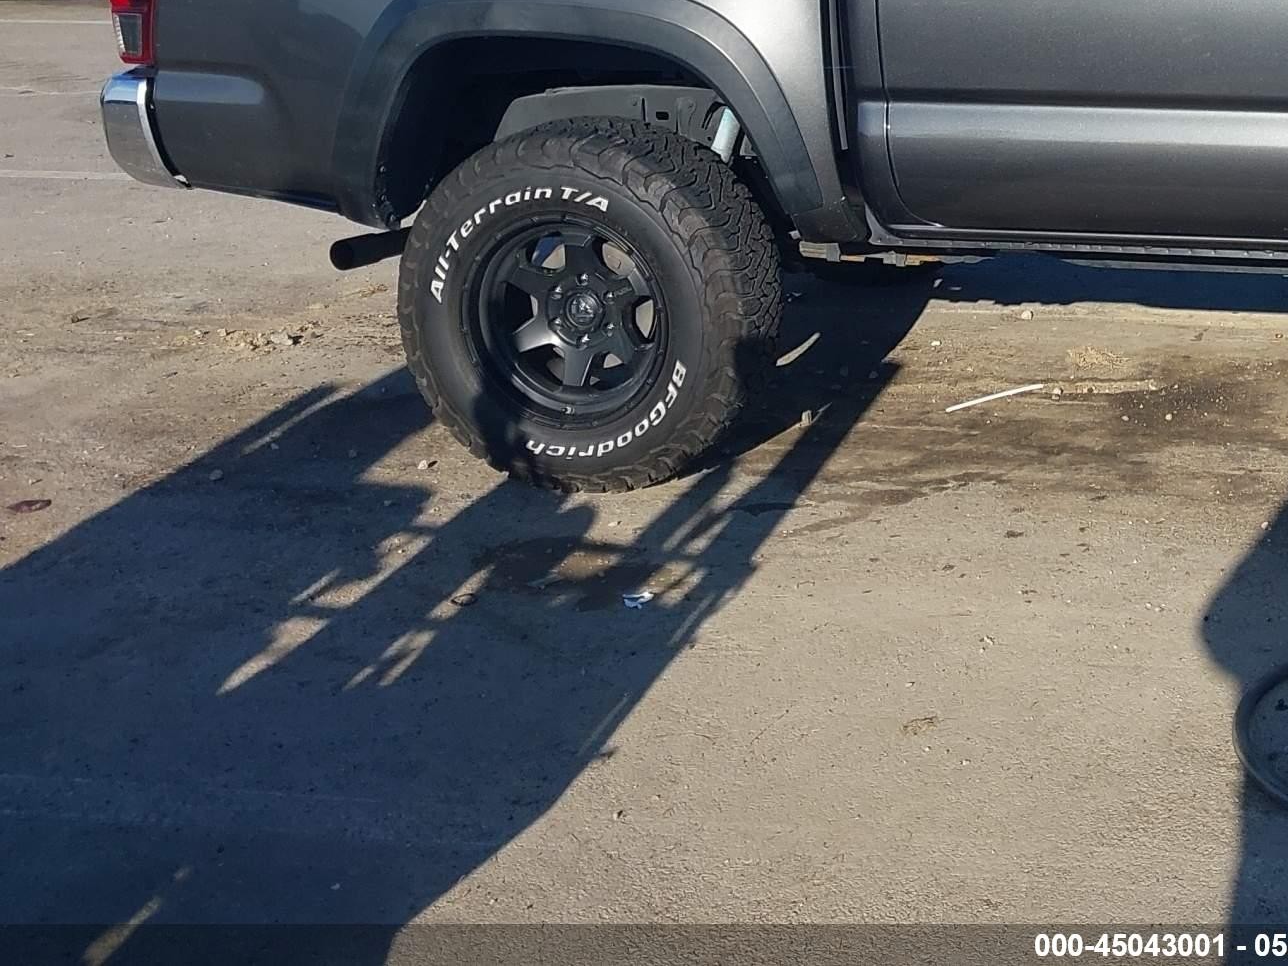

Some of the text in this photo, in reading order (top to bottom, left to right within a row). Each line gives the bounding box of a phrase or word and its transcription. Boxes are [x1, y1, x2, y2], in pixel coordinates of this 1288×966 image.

[430, 185, 610, 304] All-Terrain T/A
[525, 359, 688, 460] BFGoodrich
